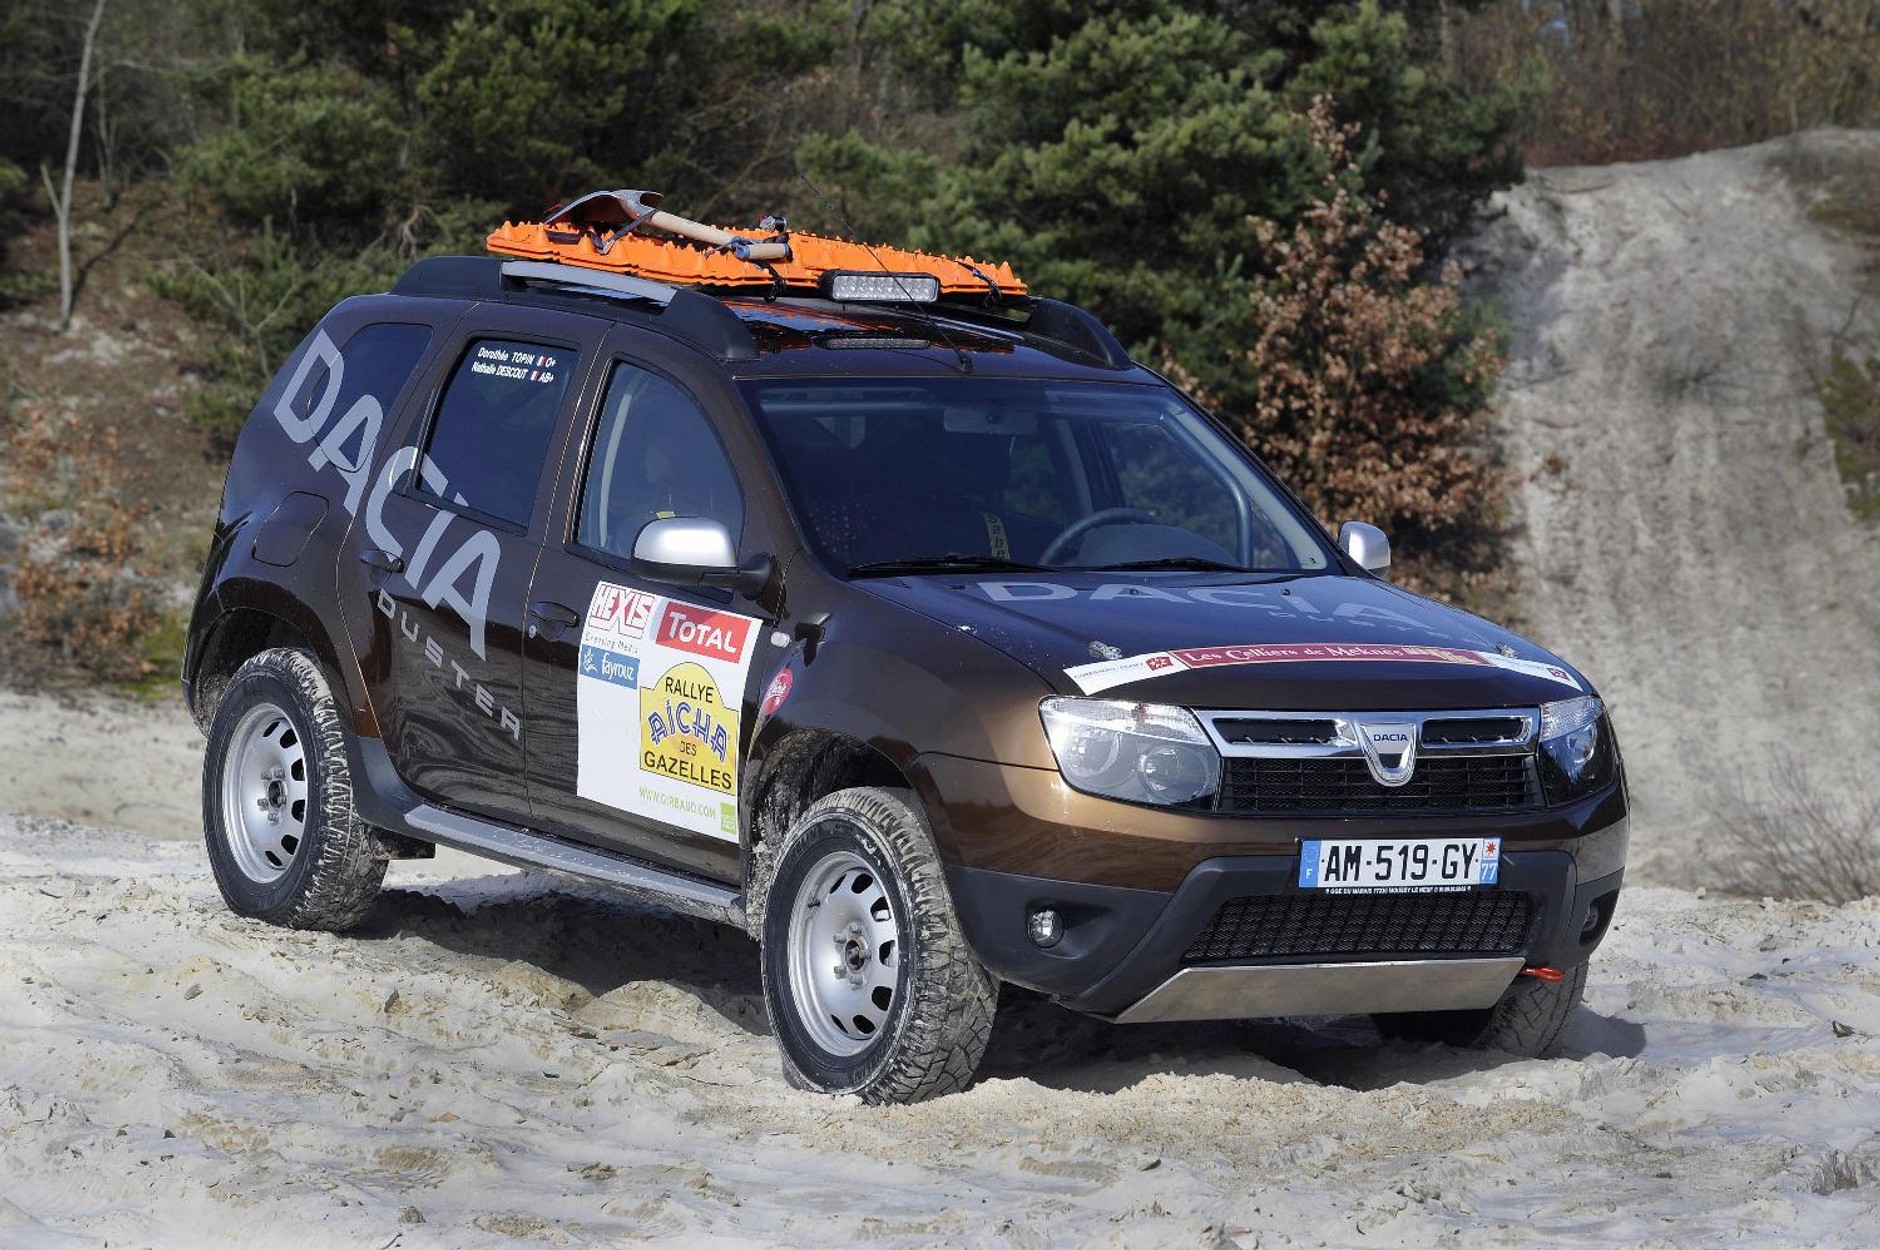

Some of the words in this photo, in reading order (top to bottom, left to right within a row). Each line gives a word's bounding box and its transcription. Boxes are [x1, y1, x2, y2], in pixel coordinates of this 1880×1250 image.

[496, 365, 528, 379] DESCOUT
[511, 351, 535, 365] TOPIN
[273, 328, 501, 662] DACIA
[588, 584, 655, 640] HEXIS
[976, 581, 1436, 630] DACIA
[669, 611, 737, 653] TOTAL
[377, 588, 520, 741] DUSTER
[602, 653, 634, 680] fayrouz
[665, 676, 714, 704] RALLYE
[680, 740, 697, 757] DES
[1373, 733, 1409, 742] DACIA
[644, 750, 732, 790] GAZELLES
[1305, 868, 1313, 879] F
[1323, 843, 1478, 882] AM-519-GY
[1481, 862, 1498, 880] 77
